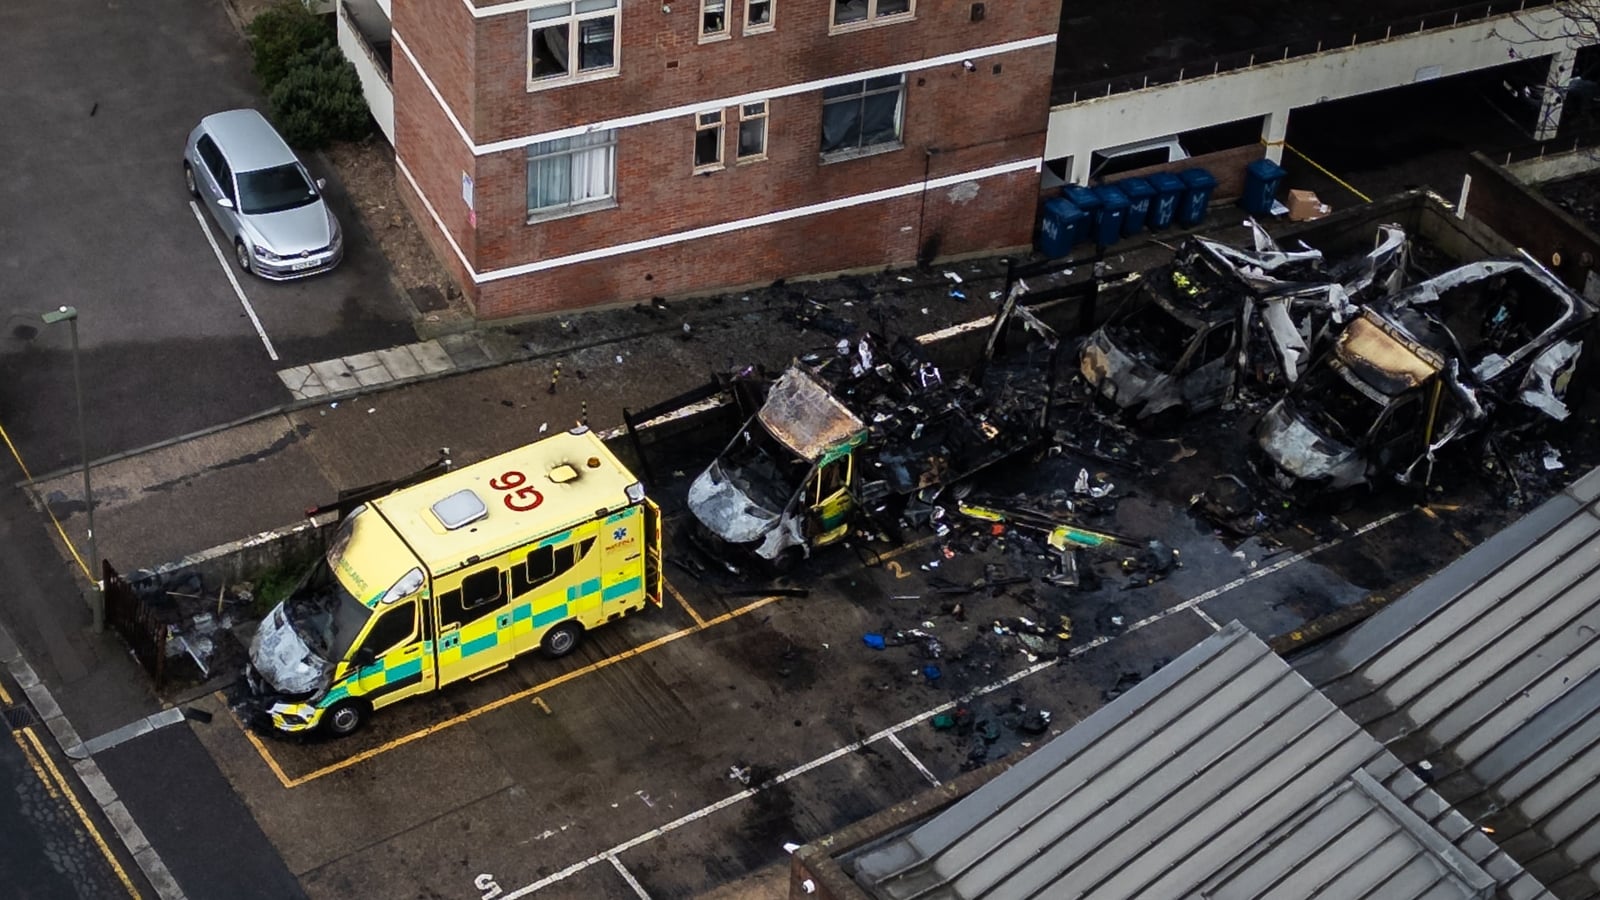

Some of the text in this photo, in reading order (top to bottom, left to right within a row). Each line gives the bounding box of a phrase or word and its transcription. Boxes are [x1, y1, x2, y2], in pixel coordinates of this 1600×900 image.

[1130, 200, 1150, 213] MH
[1160, 196, 1175, 225] MH
[1041, 218, 1059, 240] MH
[489, 471, 544, 512] G6
[887, 561, 911, 579] 2
[531, 696, 552, 714] 1
[474, 873, 503, 900] 5
